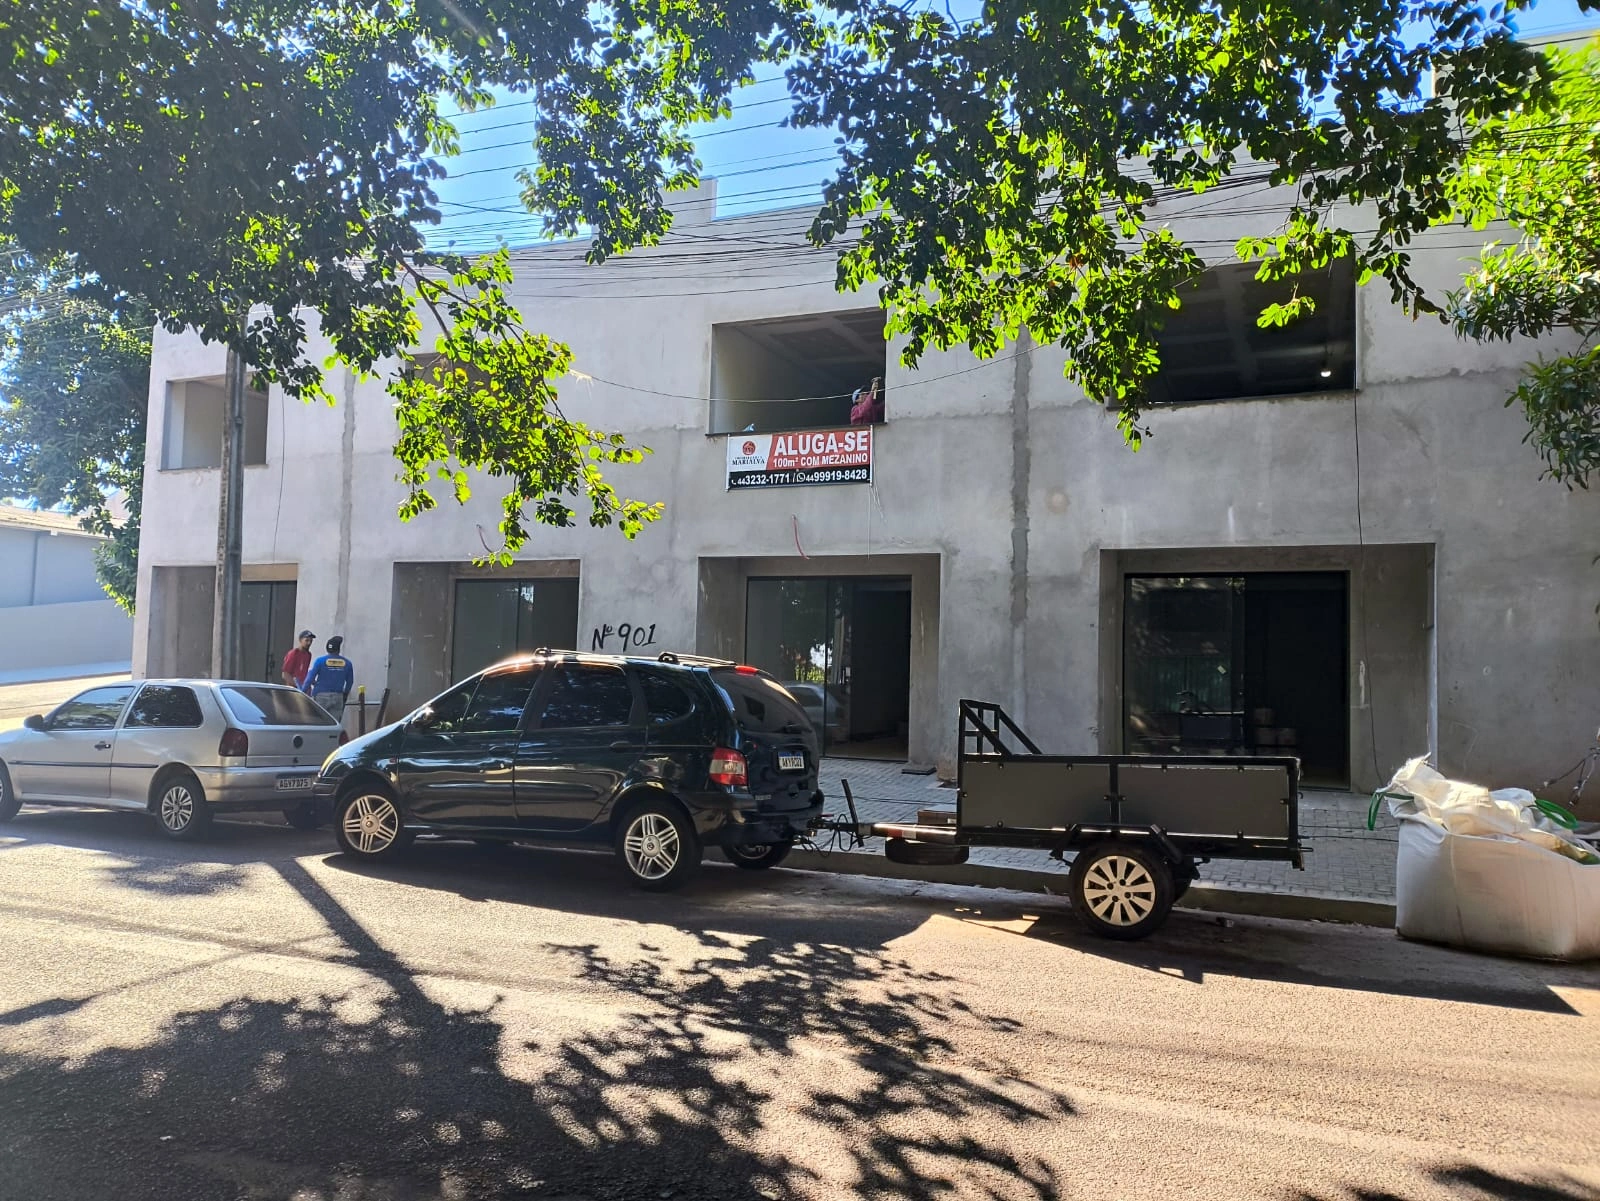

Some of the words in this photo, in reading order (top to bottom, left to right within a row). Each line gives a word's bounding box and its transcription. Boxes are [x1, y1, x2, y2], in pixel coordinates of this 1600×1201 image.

[774, 430, 868, 456] ALUGA-SE
[731, 458, 765, 466] MARIALVA
[773, 457, 799, 468] 100m²
[800, 455, 820, 467] COM
[821, 453, 868, 465] MEZANINO
[618, 623, 656, 652] 901
